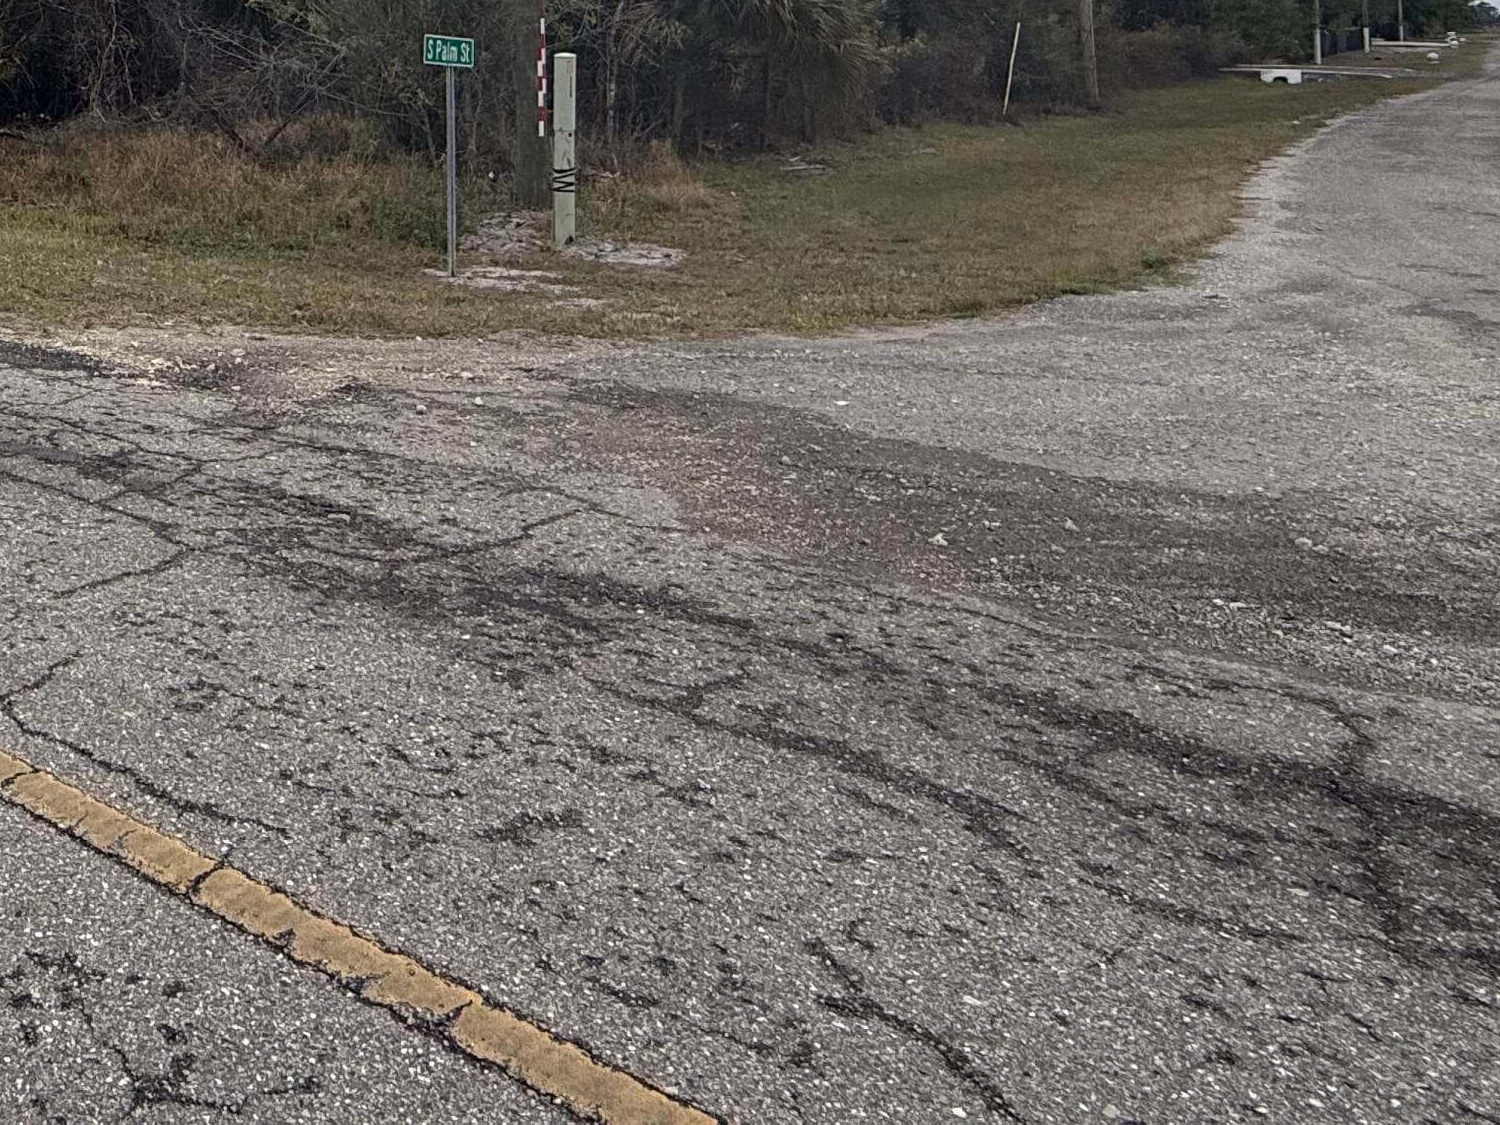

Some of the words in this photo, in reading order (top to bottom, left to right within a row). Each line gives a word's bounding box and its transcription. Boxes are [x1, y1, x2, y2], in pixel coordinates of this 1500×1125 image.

[427, 39, 434, 60] S
[435, 39, 458, 62] Palm
[460, 42, 470, 63] St
